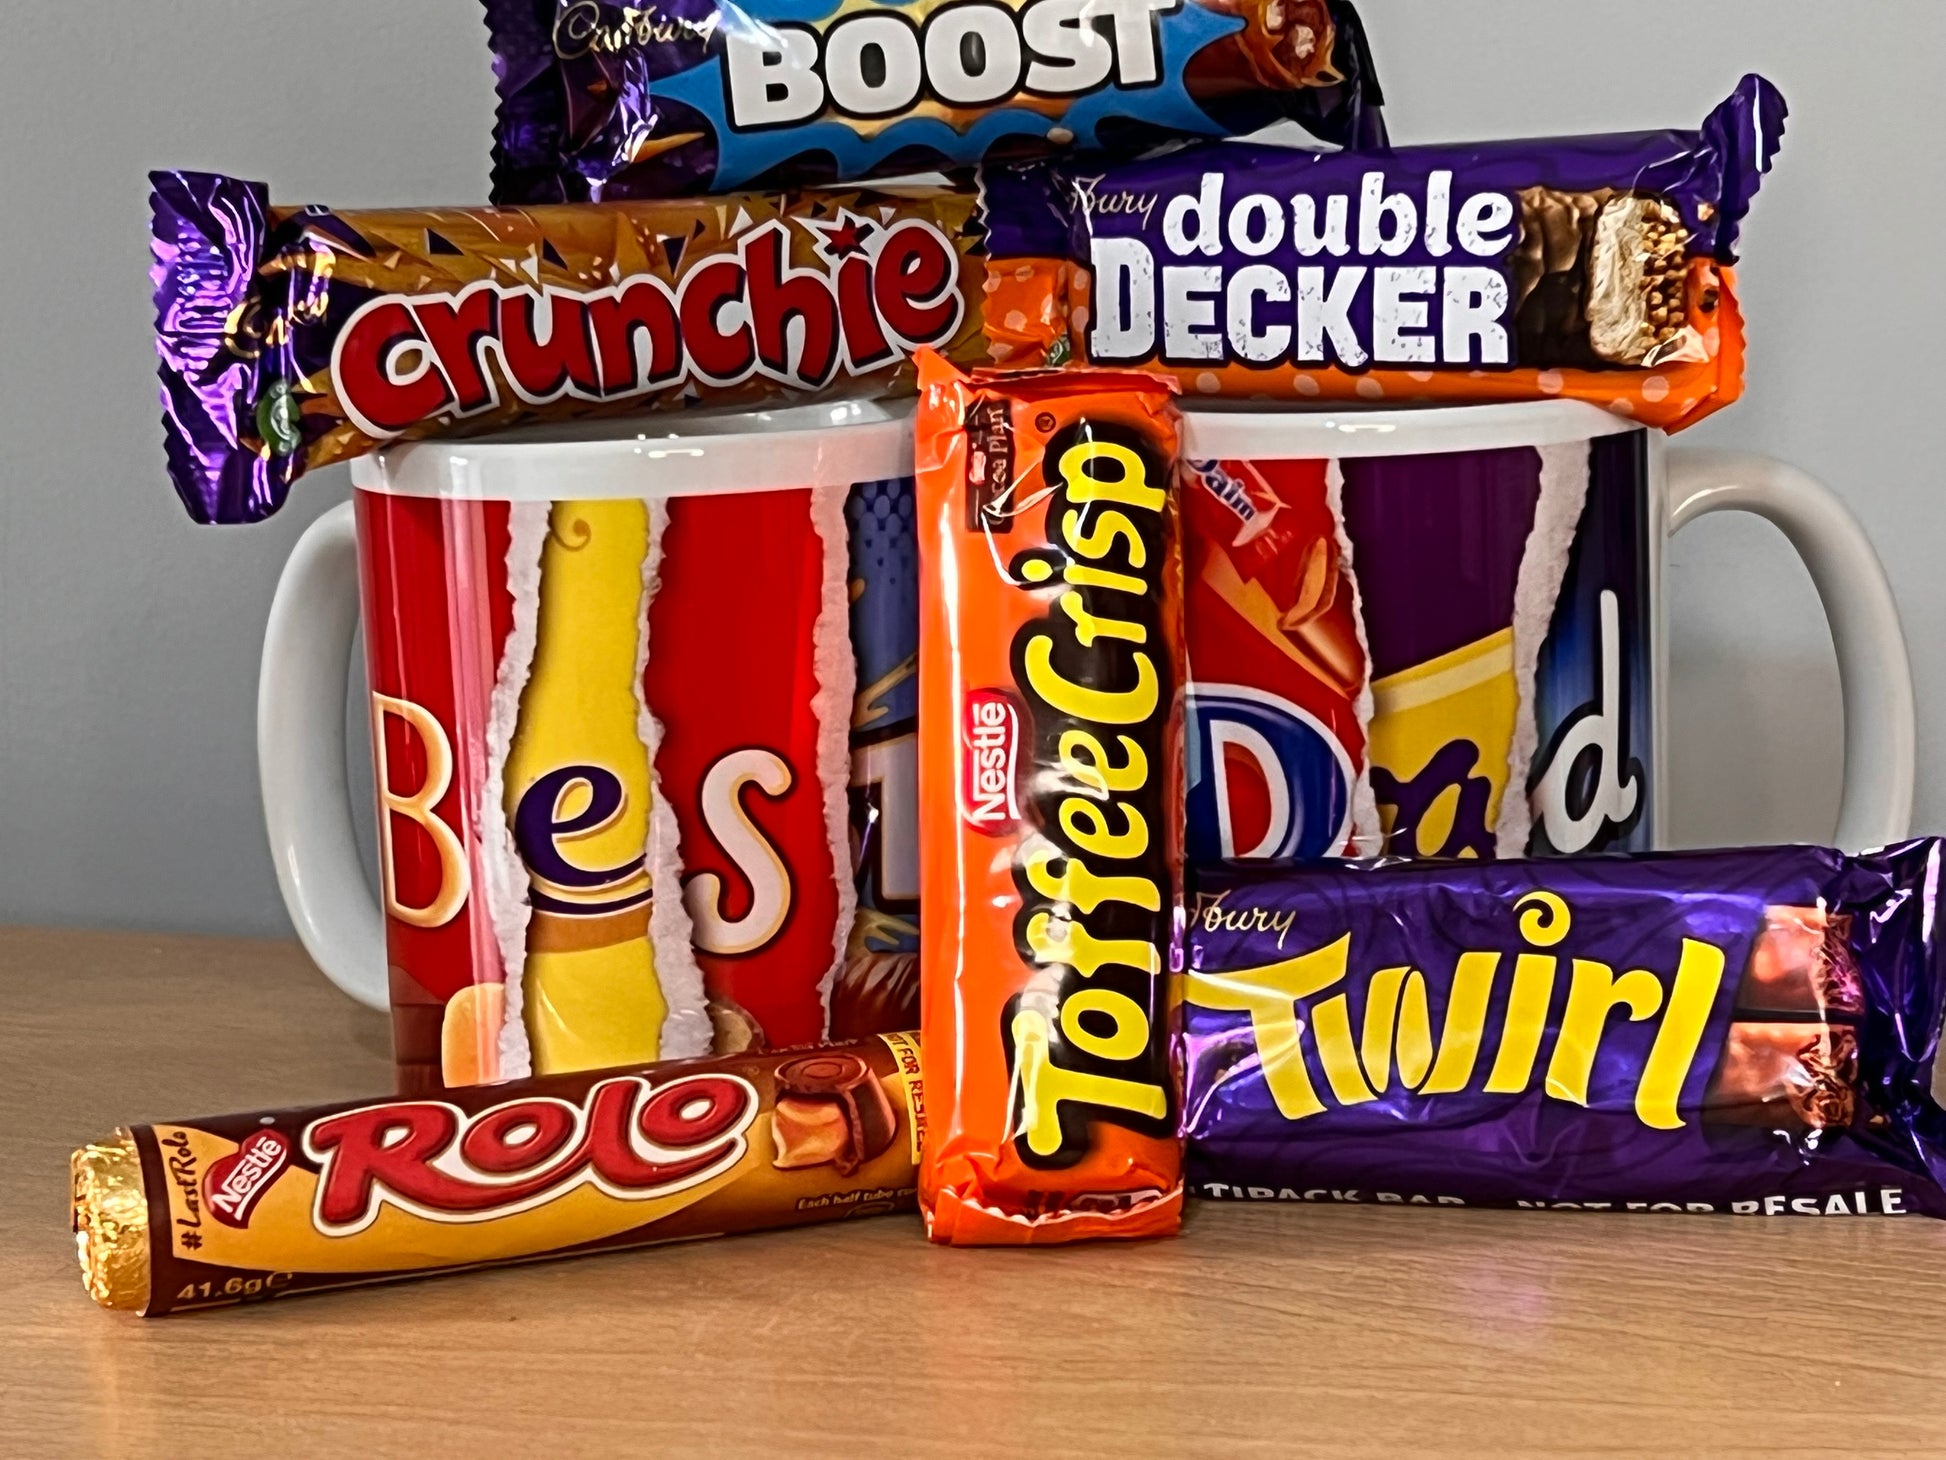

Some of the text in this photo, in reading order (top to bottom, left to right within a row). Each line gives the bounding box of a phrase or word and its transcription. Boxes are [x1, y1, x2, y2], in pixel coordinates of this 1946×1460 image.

[726, 0, 1176, 126] BOOST
[1162, 170, 1514, 257] double
[1090, 238, 1509, 366] DECKER
[1012, 441, 1167, 1156] Toffee Crisp
[1182, 892, 1725, 1129] Twirl
[304, 1074, 757, 1235] Rolo
